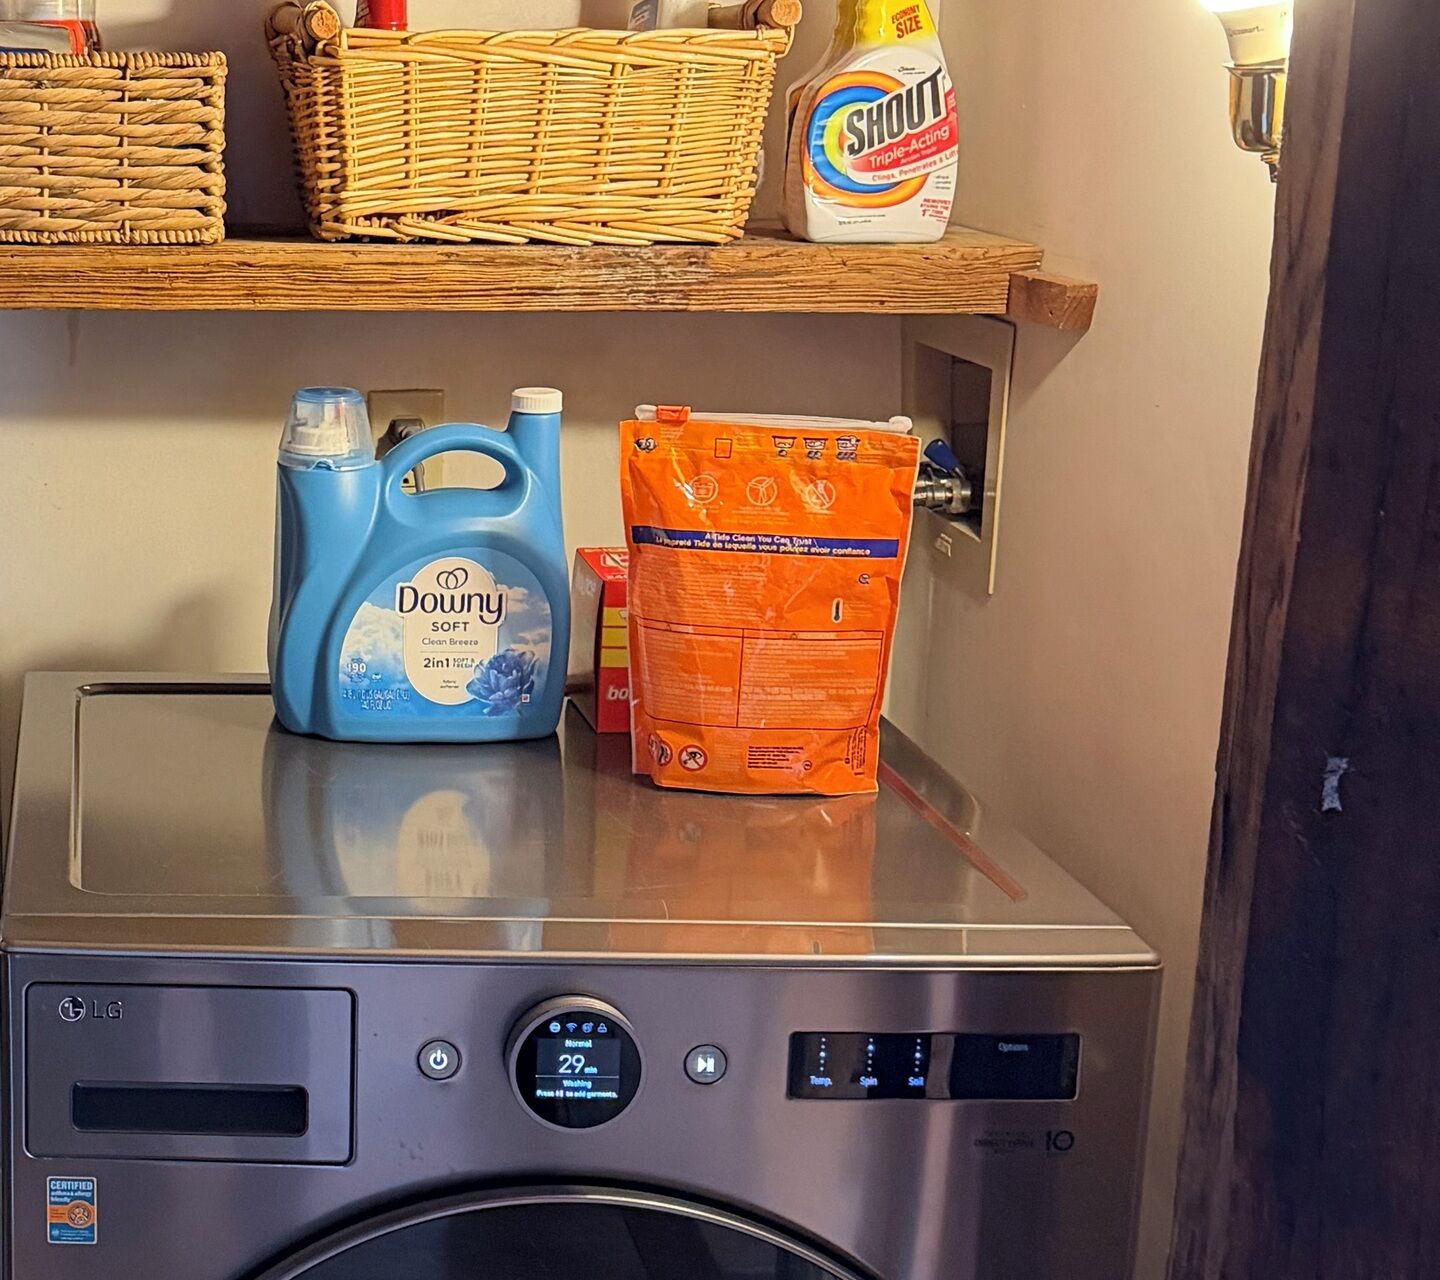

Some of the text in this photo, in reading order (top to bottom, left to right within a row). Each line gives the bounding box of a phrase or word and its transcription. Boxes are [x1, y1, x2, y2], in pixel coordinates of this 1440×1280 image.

[891, 4, 921, 24] ECONOMY
[895, 14, 923, 39] SIZE
[846, 64, 943, 157] SHOUT
[869, 125, 950, 168] Triple-Acting
[713, 532, 730, 541] Tide
[732, 534, 756, 543] Clean
[758, 535, 772, 543] You
[774, 536, 789, 544] Can
[792, 537, 812, 545] Trust
[694, 540, 711, 548] Tide
[832, 547, 871, 556] confiance
[398, 586, 504, 625] Downy
[431, 622, 470, 633] SOFT
[421, 637, 479, 646] Clean Breeze
[348, 662, 367, 673] 190
[423, 657, 450, 669] 2in1
[92, 999, 123, 1019] LG
[564, 1039, 593, 1048] Normal
[558, 1054, 585, 1074] 29
[562, 1080, 593, 1089] Washing
[809, 1075, 833, 1087] Temp.
[859, 1075, 878, 1088] Spin
[907, 1076, 924, 1087] Soil
[535, 1090, 555, 1098] Press
[586, 1091, 619, 1099] garments.
[50, 1180, 93, 1190] CERTIFIED
